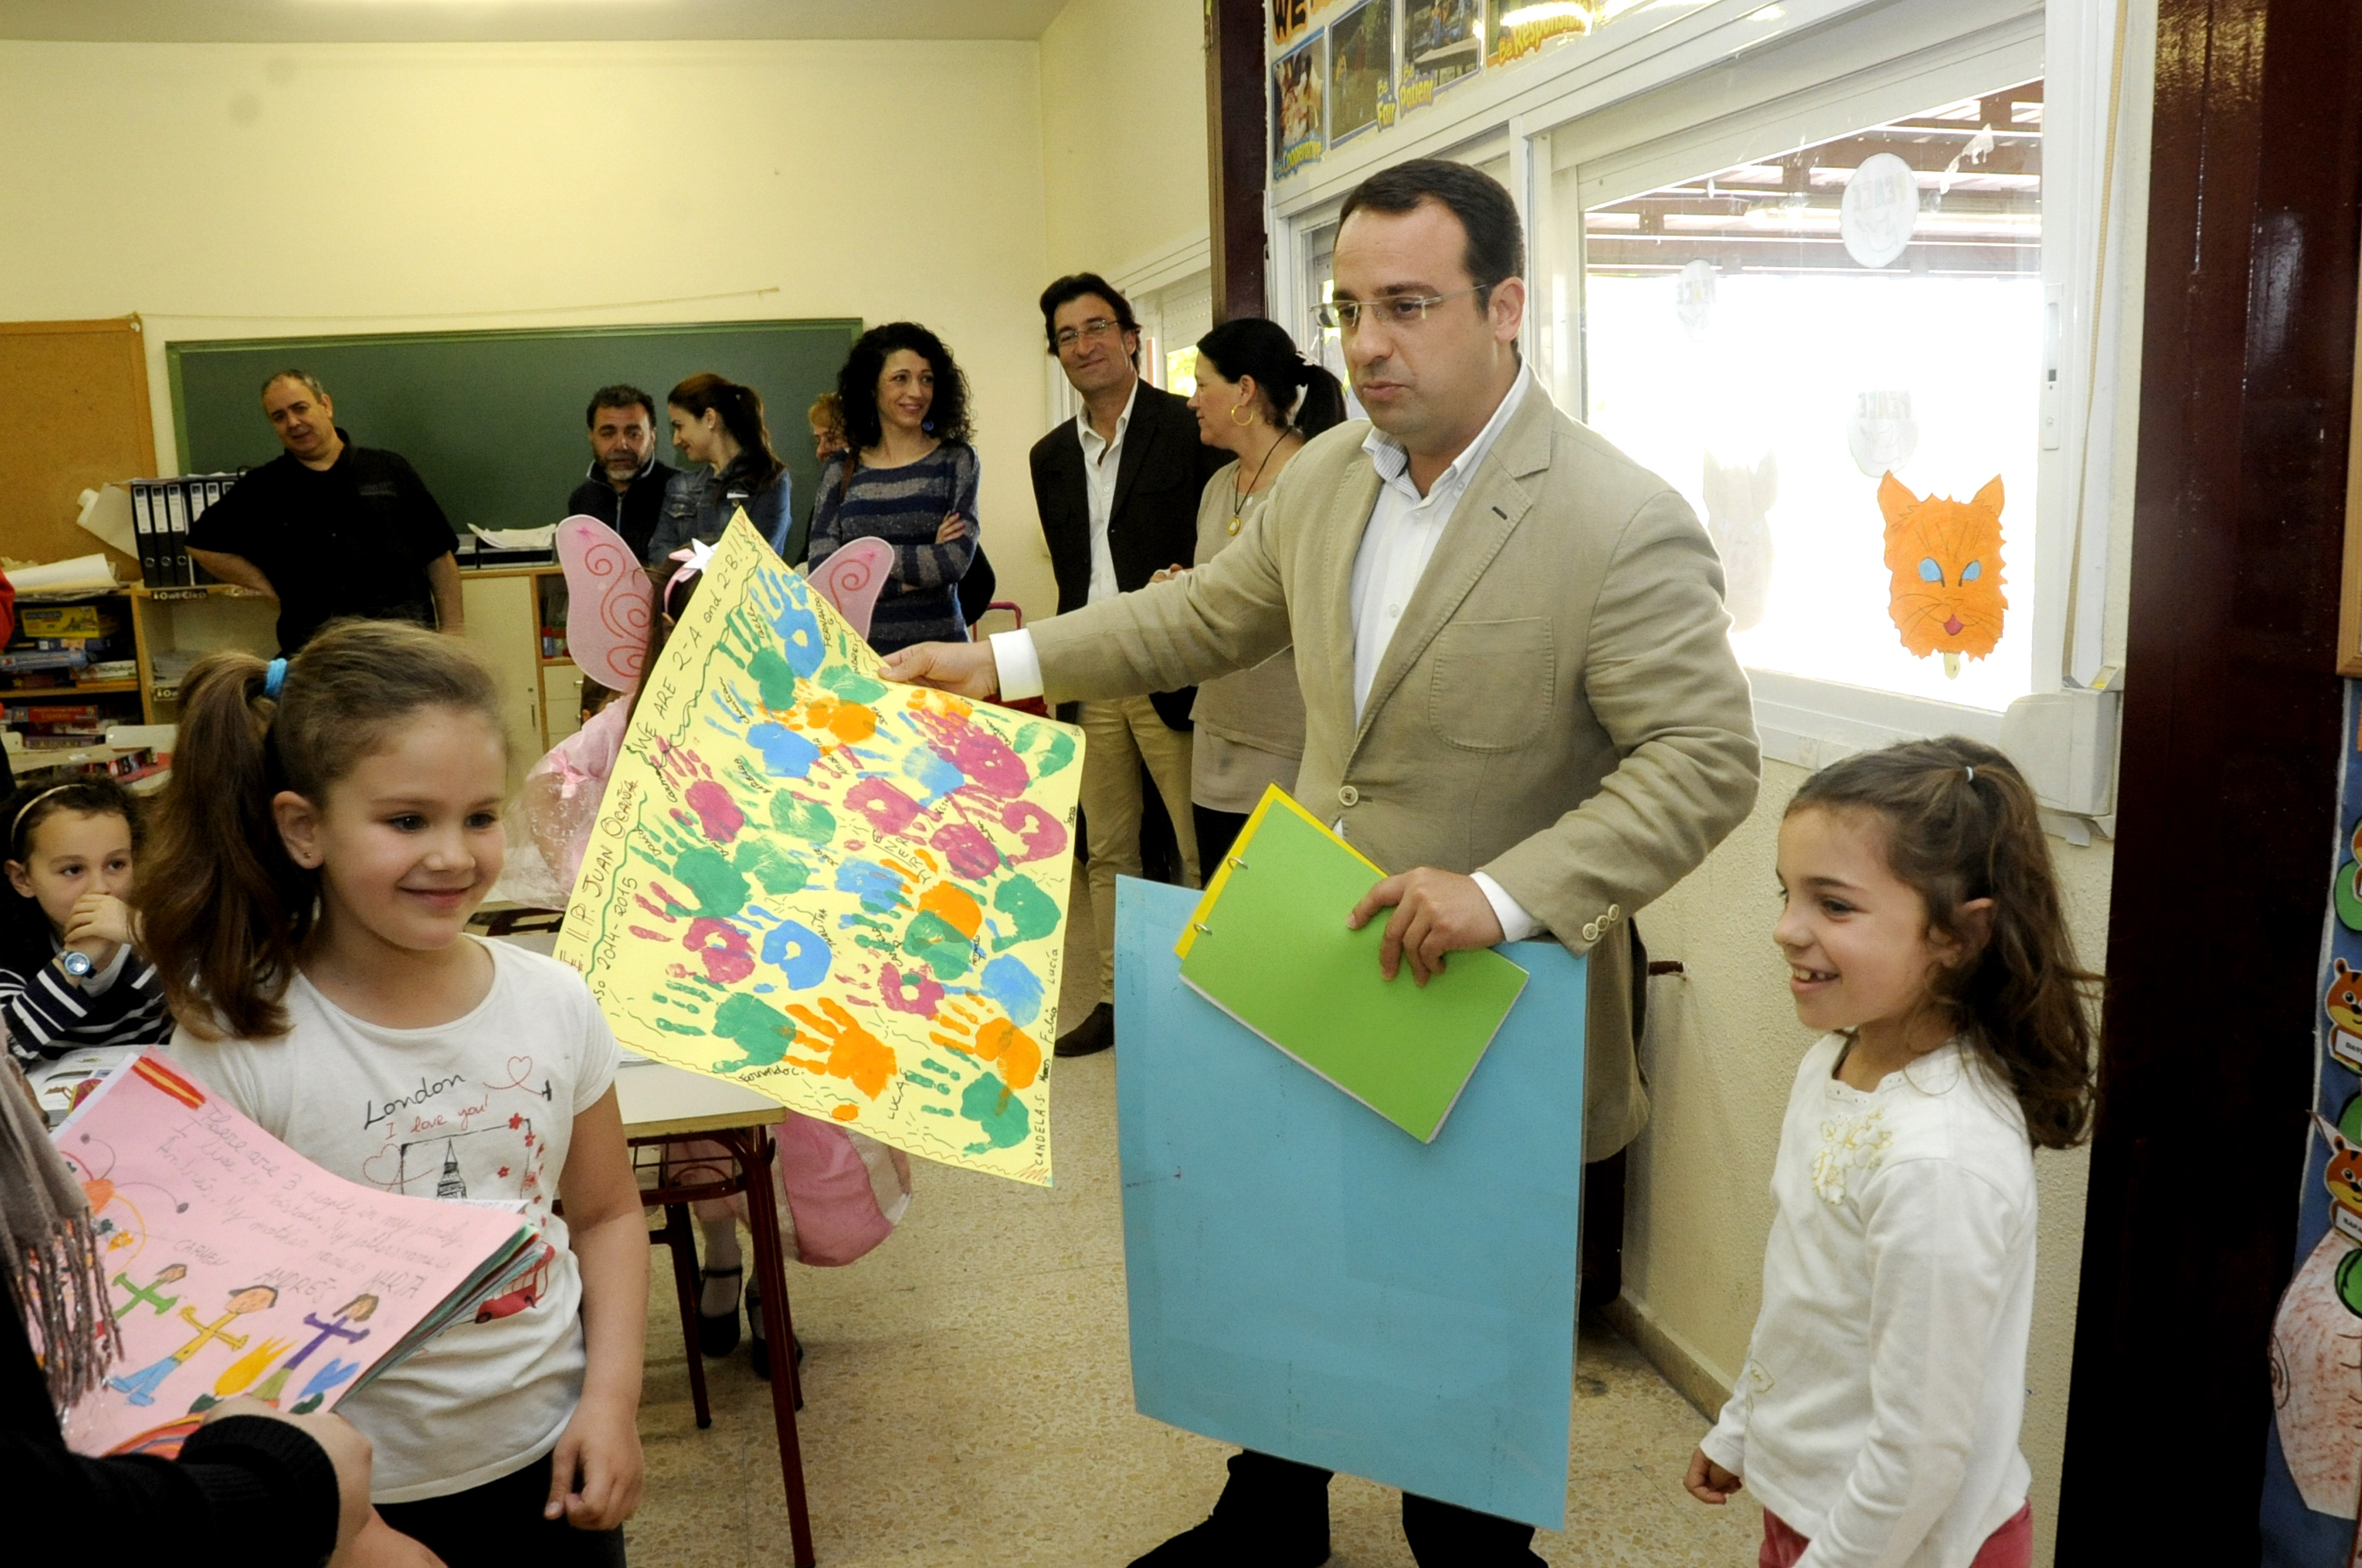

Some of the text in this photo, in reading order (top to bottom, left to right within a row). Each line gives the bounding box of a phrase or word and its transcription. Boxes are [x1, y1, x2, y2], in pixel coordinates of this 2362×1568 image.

[1376, 94, 1396, 127] Fair
[631, 722, 658, 750] WE
[653, 676, 676, 720] ARE
[703, 590, 722, 624] and
[582, 844, 613, 898] JUAN
[364, 1074, 467, 1130] London
[385, 1094, 489, 1140] I love you!
